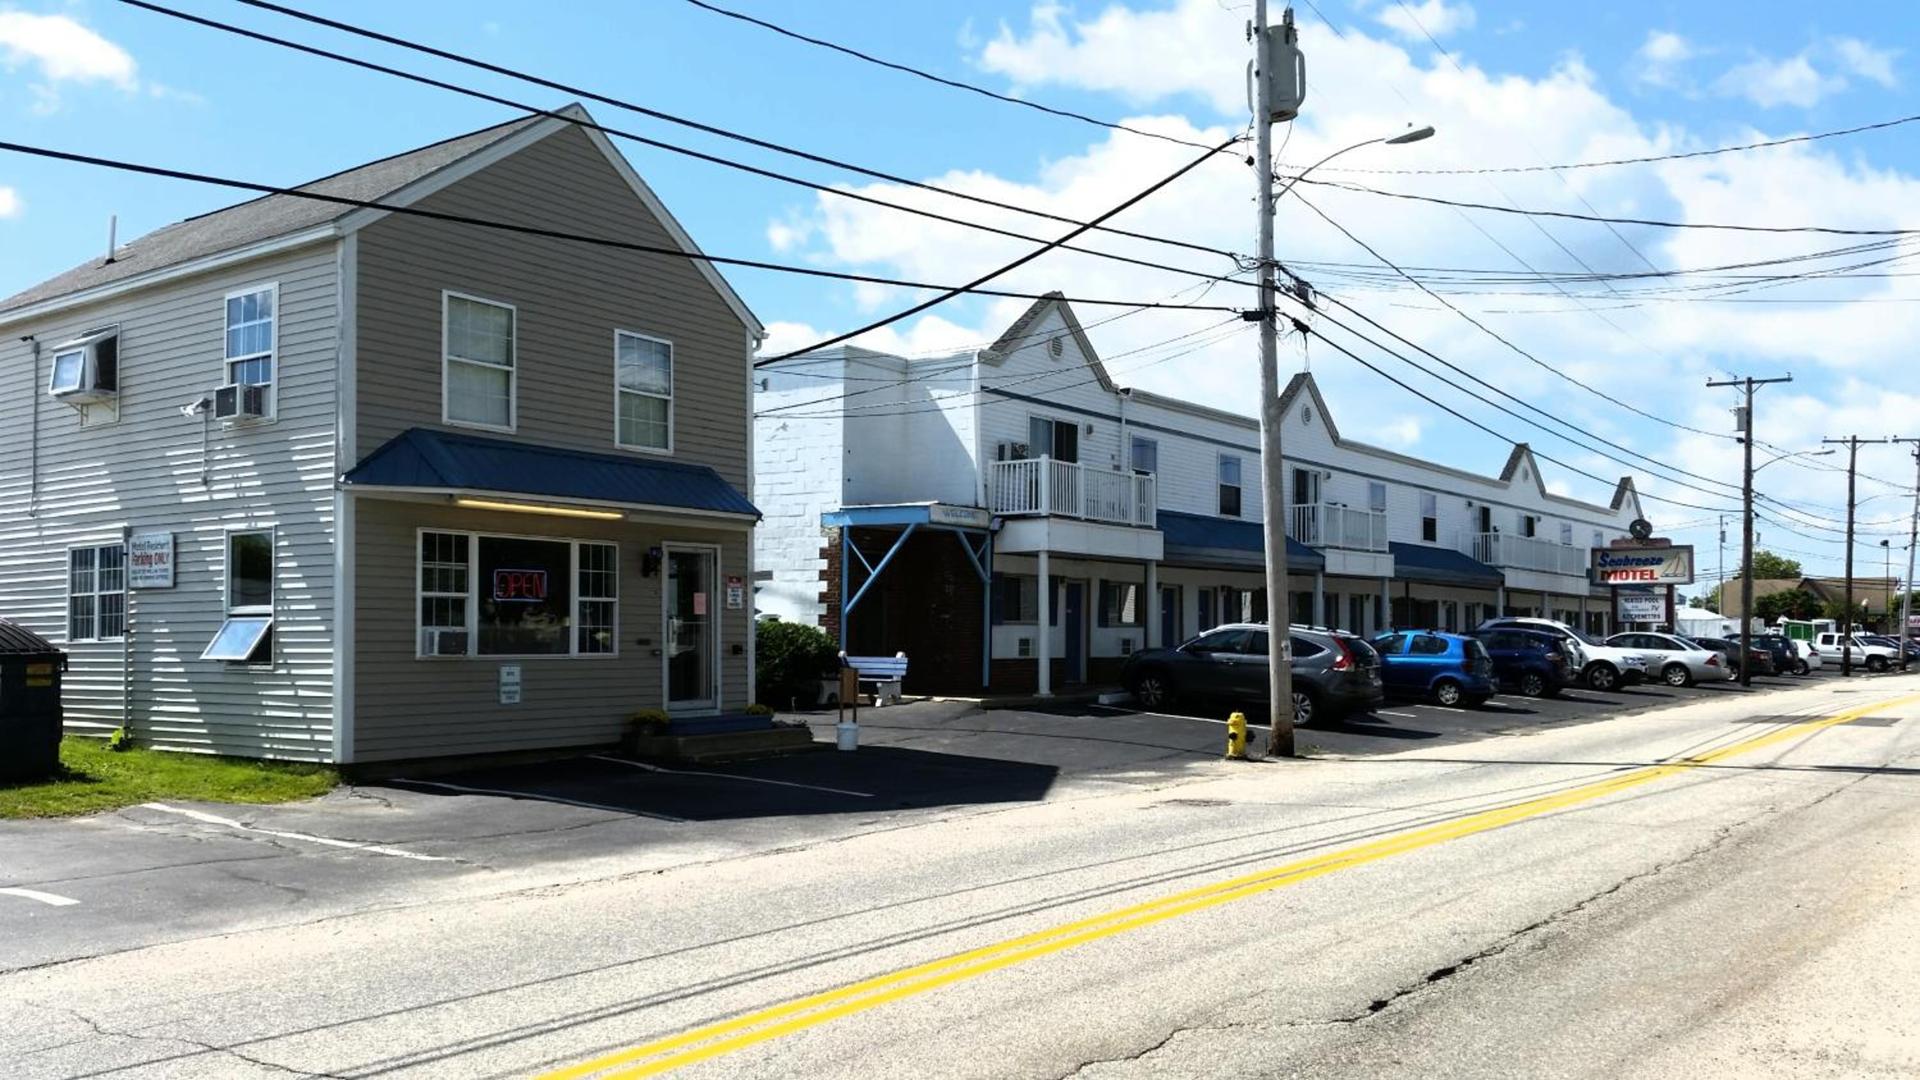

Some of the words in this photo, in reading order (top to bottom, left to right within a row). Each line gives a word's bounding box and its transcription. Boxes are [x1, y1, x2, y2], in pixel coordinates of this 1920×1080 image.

[131, 552, 153, 568] Parking
[1598, 550, 1664, 568] Seabreeze
[1600, 568, 1659, 582] MOTEL
[496, 572, 546, 599] OPEN
